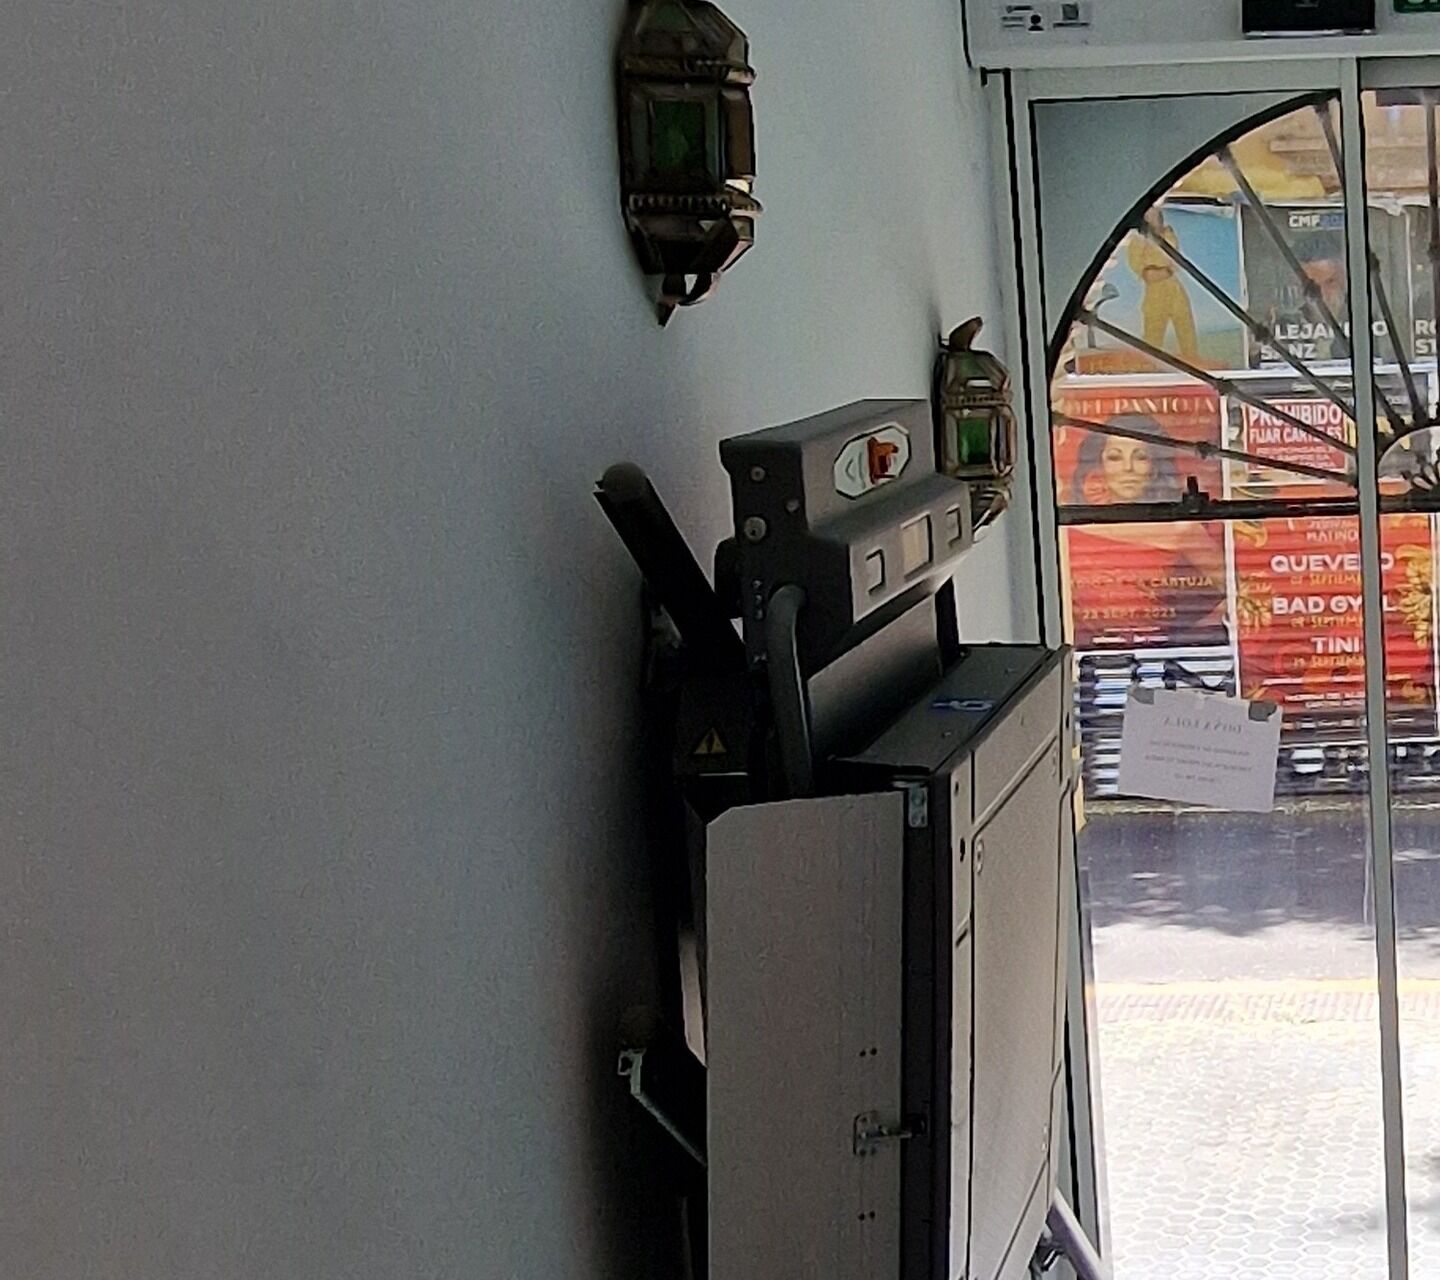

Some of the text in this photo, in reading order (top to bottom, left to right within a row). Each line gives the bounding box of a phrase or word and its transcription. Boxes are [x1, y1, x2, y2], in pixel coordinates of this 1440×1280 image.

[1261, 343, 1317, 360] SNZ
[1114, 396, 1218, 414] PANTOJA
[1271, 552, 1394, 573] QUEVEO
[1151, 575, 1214, 588] CARTUJA
[1272, 595, 1398, 614] BAD GYL
[1311, 636, 1360, 654] TINI
